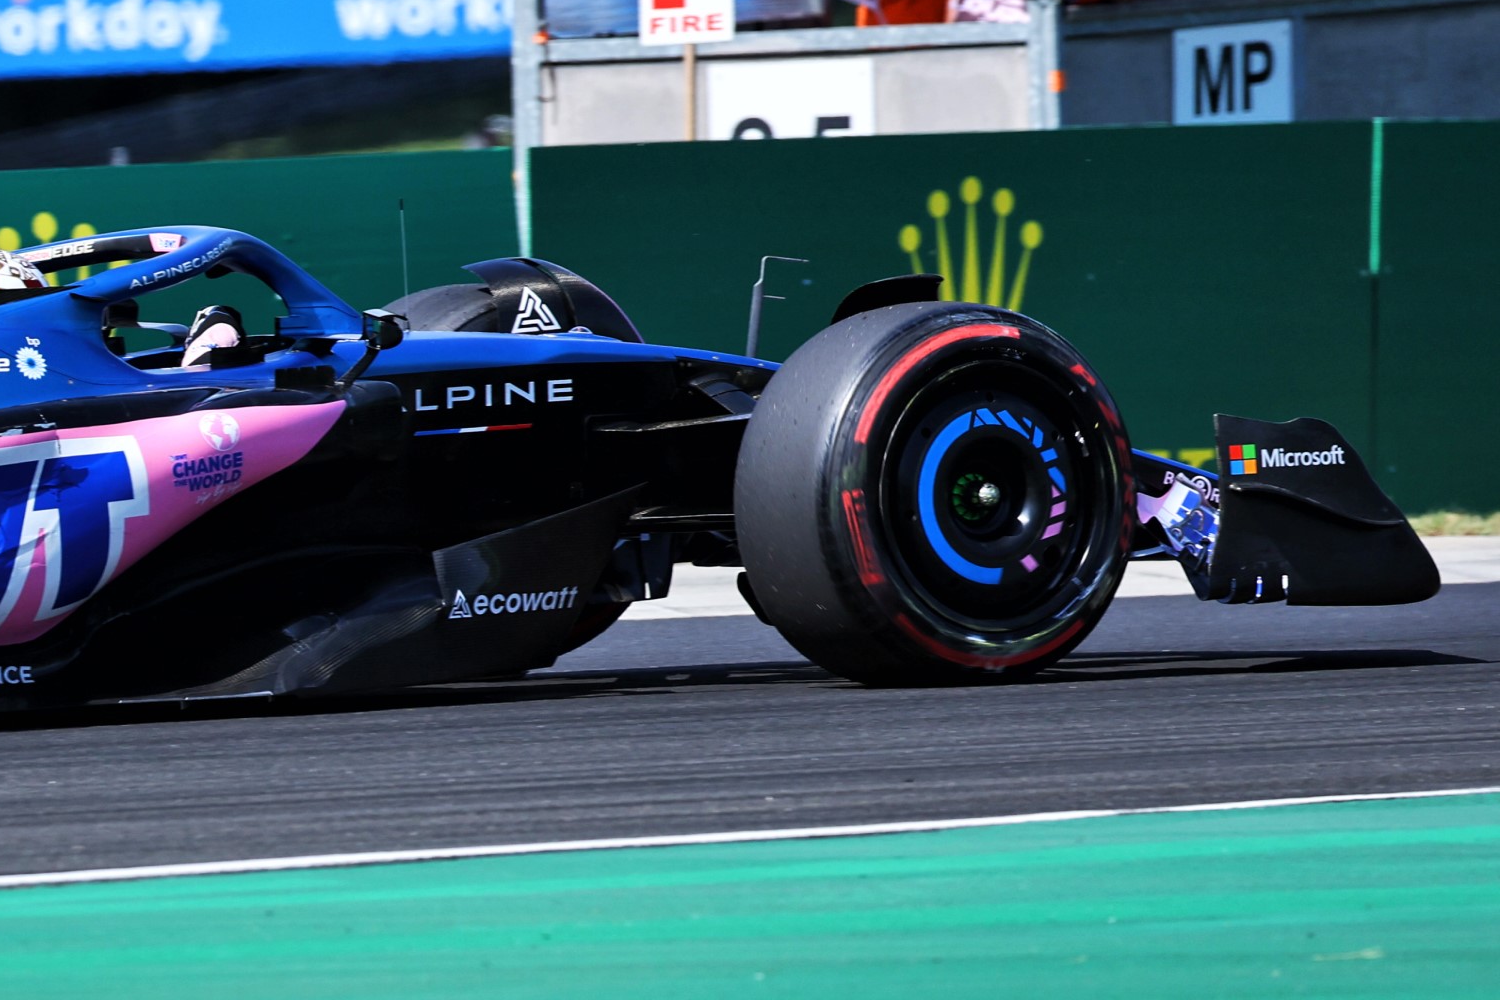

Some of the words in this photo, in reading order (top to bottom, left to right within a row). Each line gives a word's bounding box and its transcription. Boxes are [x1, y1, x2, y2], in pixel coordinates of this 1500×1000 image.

[649, 11, 725, 34] FIRE
[1193, 40, 1275, 117] MP
[51, 241, 95, 259] EDGE
[402, 379, 574, 413] LPINE
[172, 451, 244, 479] CHANGE
[1260, 444, 1346, 468] Microsoft
[187, 469, 242, 492] WORLD
[472, 586, 579, 616] ecowatt
